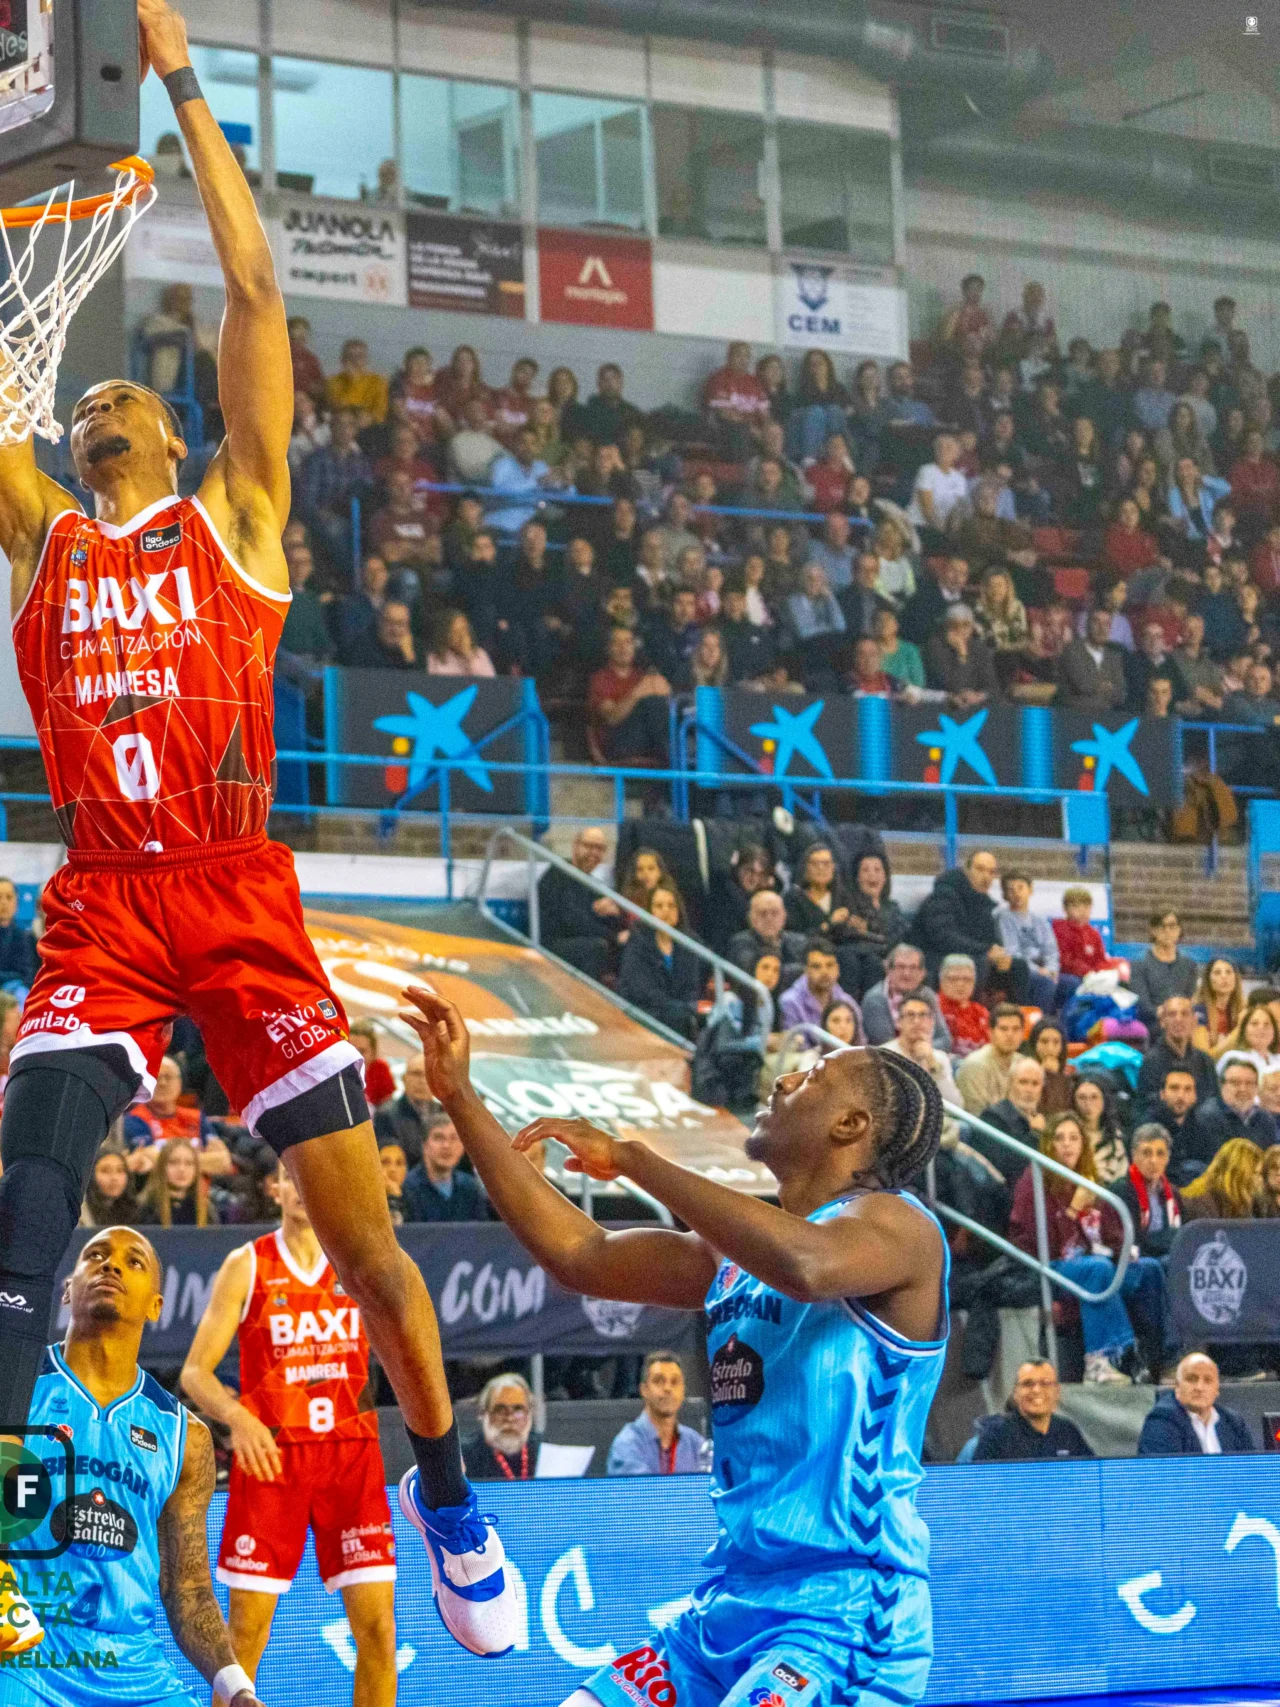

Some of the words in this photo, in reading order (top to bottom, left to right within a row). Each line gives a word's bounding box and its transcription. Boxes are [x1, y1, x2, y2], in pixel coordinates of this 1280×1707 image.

[284, 208, 394, 242] JUANOLA
[788, 313, 841, 335] CEM
[145, 535, 162, 544] liga
[145, 535, 180, 550] endesa
[61, 566, 197, 635] BAXI
[74, 667, 181, 708] MANRESA
[112, 732, 160, 801] 0
[281, 1024, 331, 1059] GLOB
[506, 1080, 717, 1118] OBSA
[1194, 1268, 1245, 1289] BAXI
[269, 1308, 360, 1346] BAXI
[285, 1362, 349, 1385] MANRESA
[308, 1397, 336, 1433] 8
[42, 1455, 150, 1500] BREOGÁN
[72, 1505, 125, 1531] Estrella
[342, 1538, 365, 1554] ETL
[774, 1667, 799, 1689] acb
